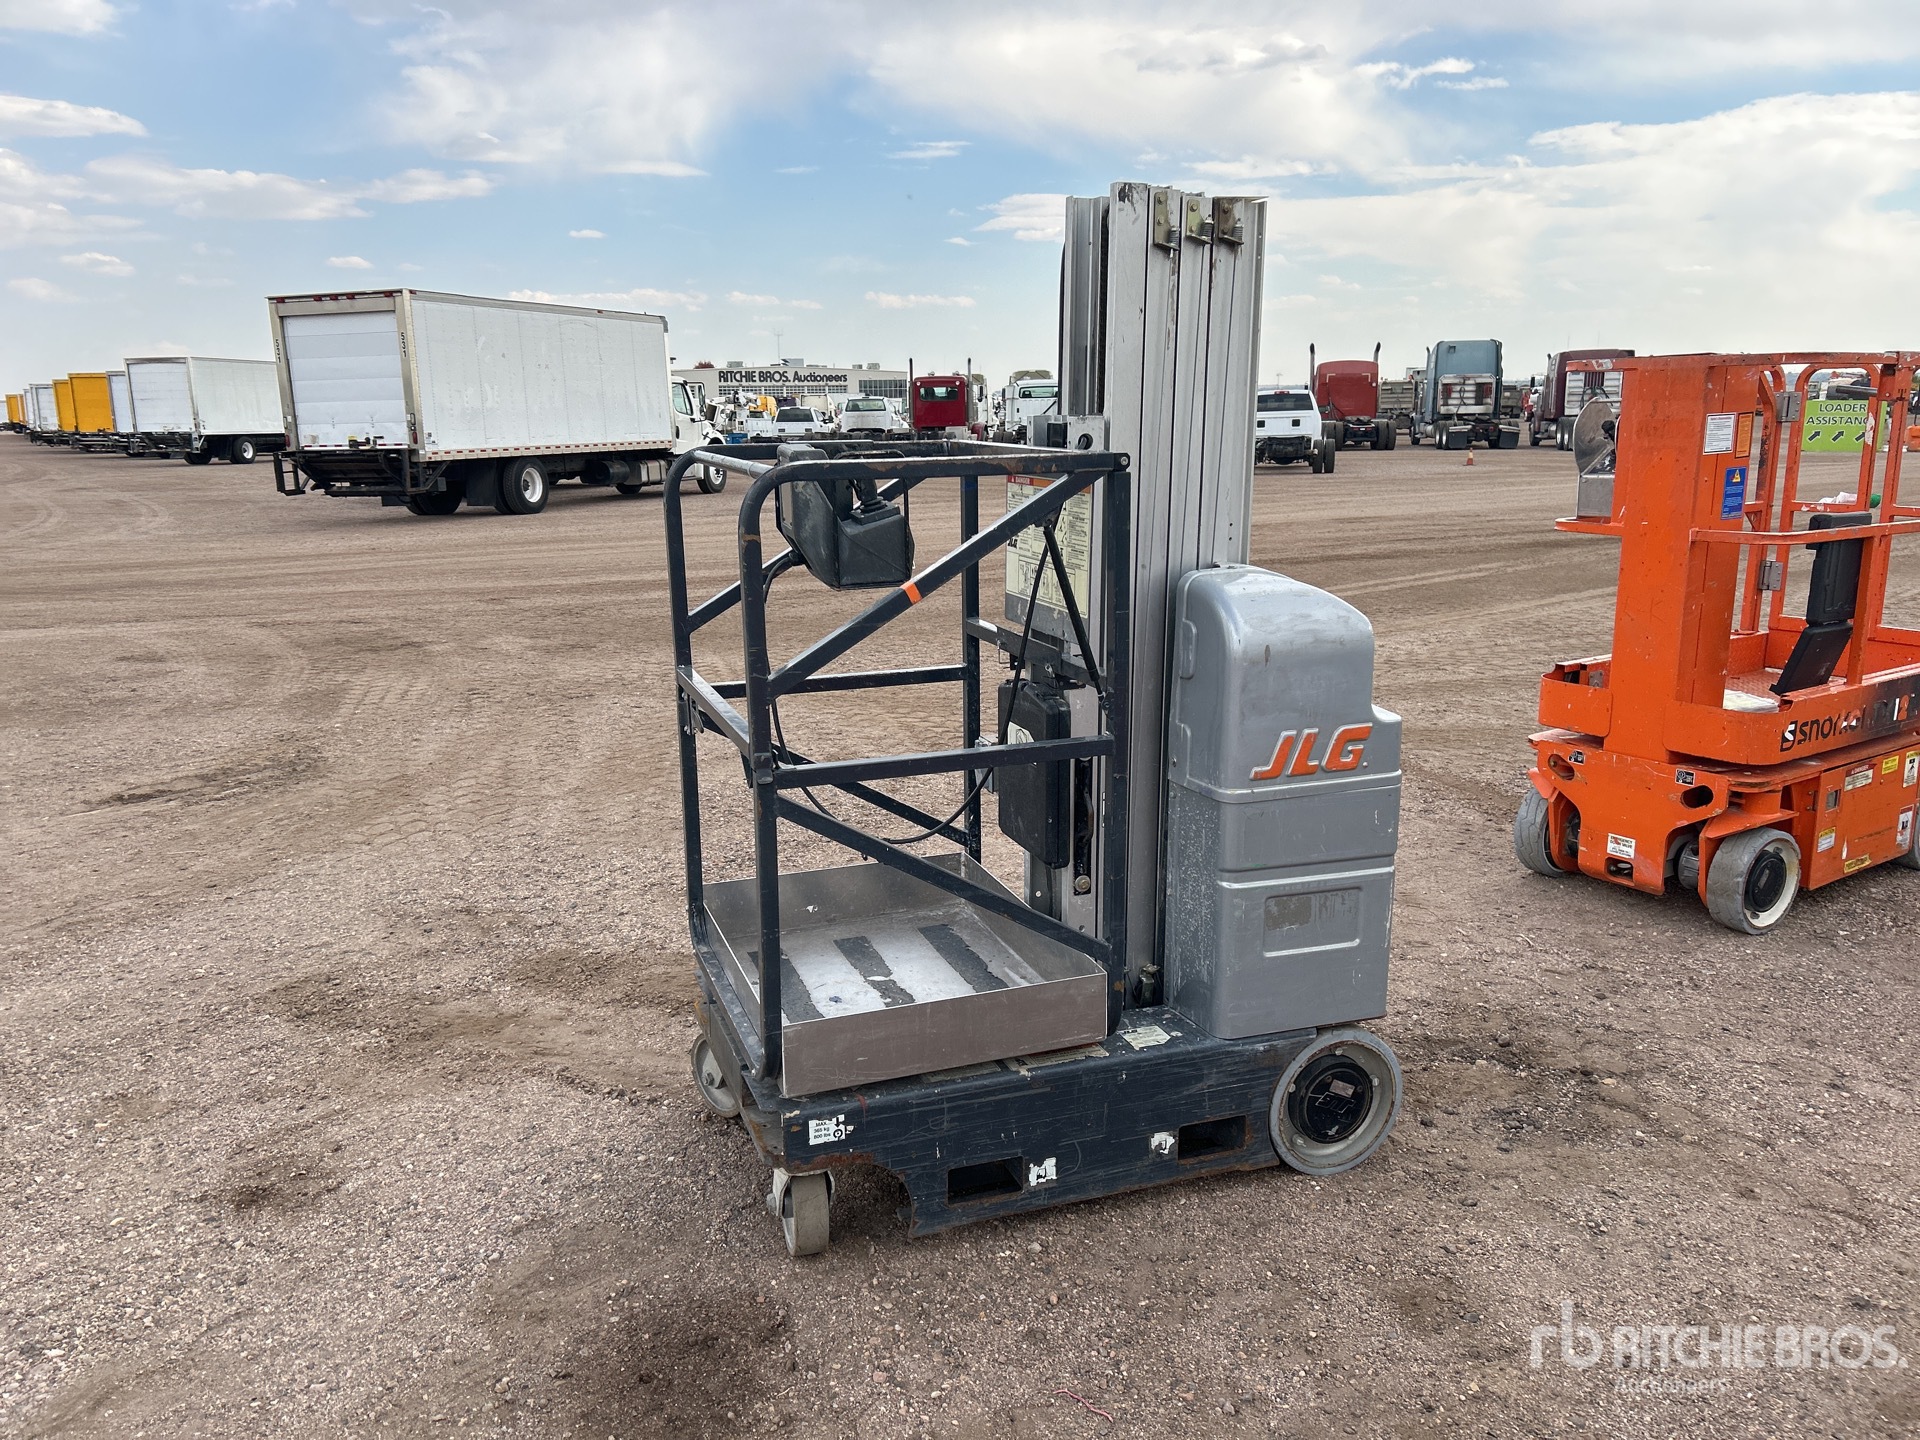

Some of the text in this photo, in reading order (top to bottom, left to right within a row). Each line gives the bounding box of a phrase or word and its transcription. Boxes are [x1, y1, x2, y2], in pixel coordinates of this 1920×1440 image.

[718, 370, 848, 383] RITCHIE BROS. Auctioneers
[1819, 403, 1867, 412] LOADER
[1806, 416, 1868, 425] ASSISTANC
[1249, 722, 1373, 780] JLG
